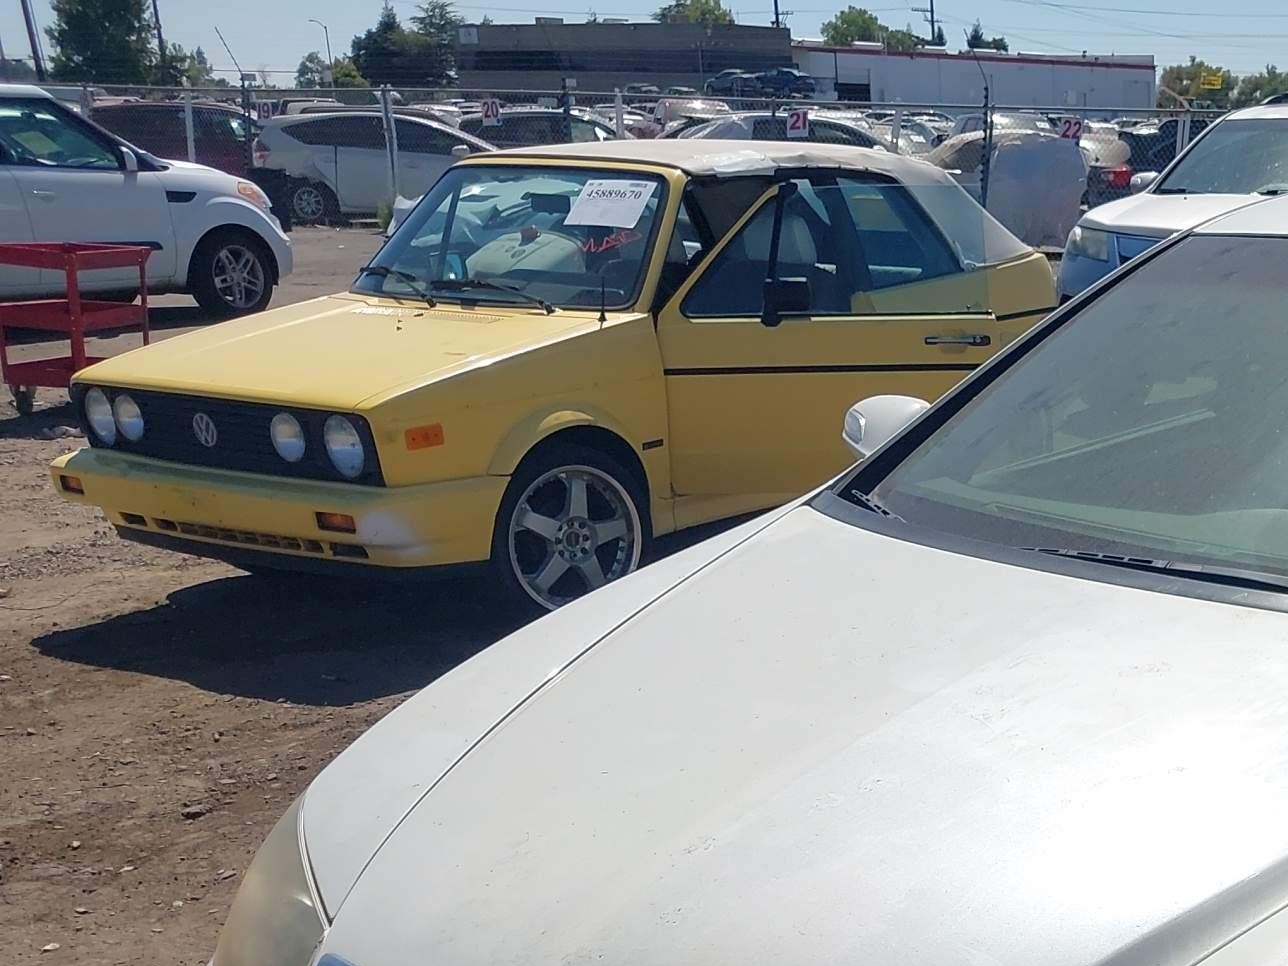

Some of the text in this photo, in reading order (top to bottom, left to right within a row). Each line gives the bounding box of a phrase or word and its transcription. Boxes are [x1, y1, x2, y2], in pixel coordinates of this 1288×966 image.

[257, 102, 270, 120] 19
[482, 100, 499, 119] 20
[789, 110, 807, 130] 21
[1061, 119, 1082, 139] 22
[586, 188, 643, 201] 45889670
